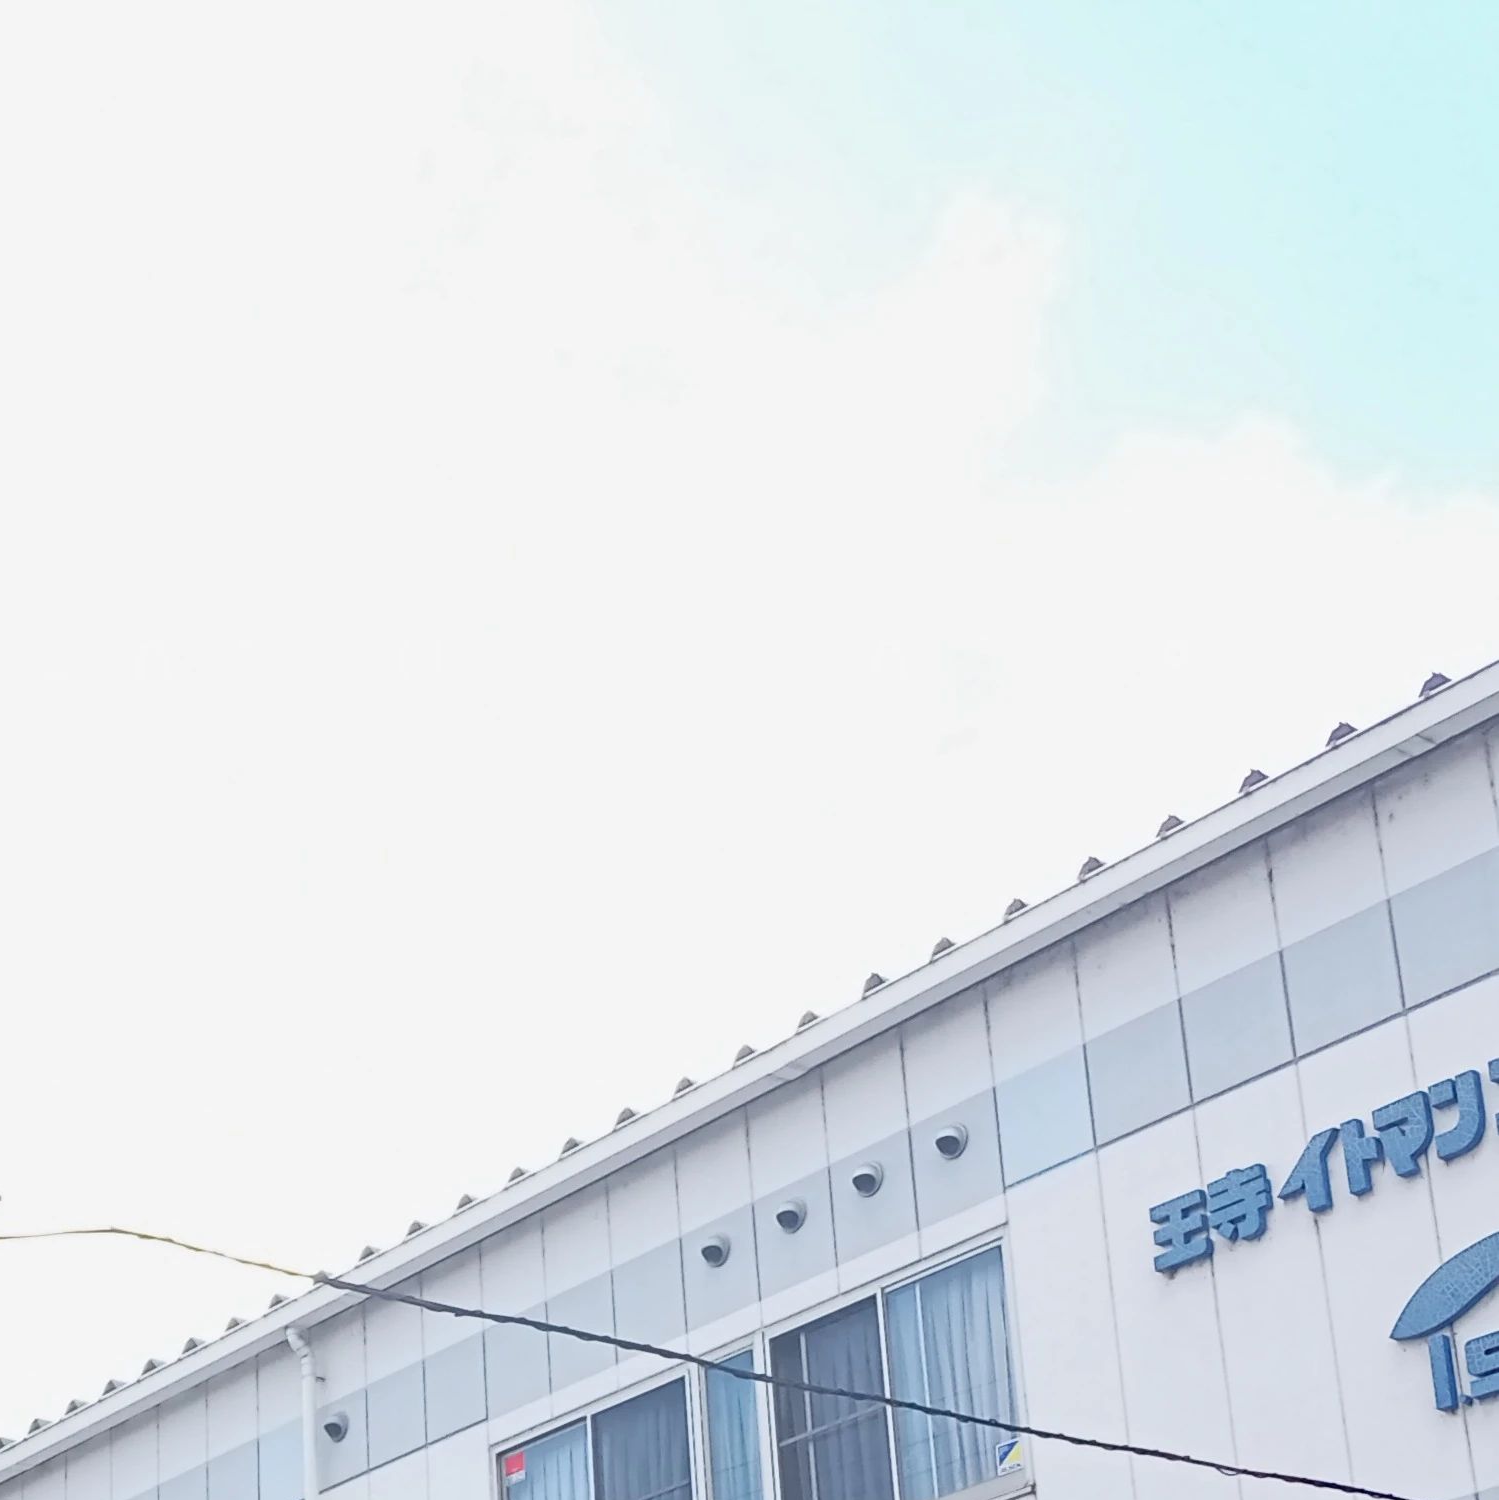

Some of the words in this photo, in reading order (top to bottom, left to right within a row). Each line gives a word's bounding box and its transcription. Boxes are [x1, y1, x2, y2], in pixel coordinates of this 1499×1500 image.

[1149, 1058, 1499, 1272] 王寺イトマン
